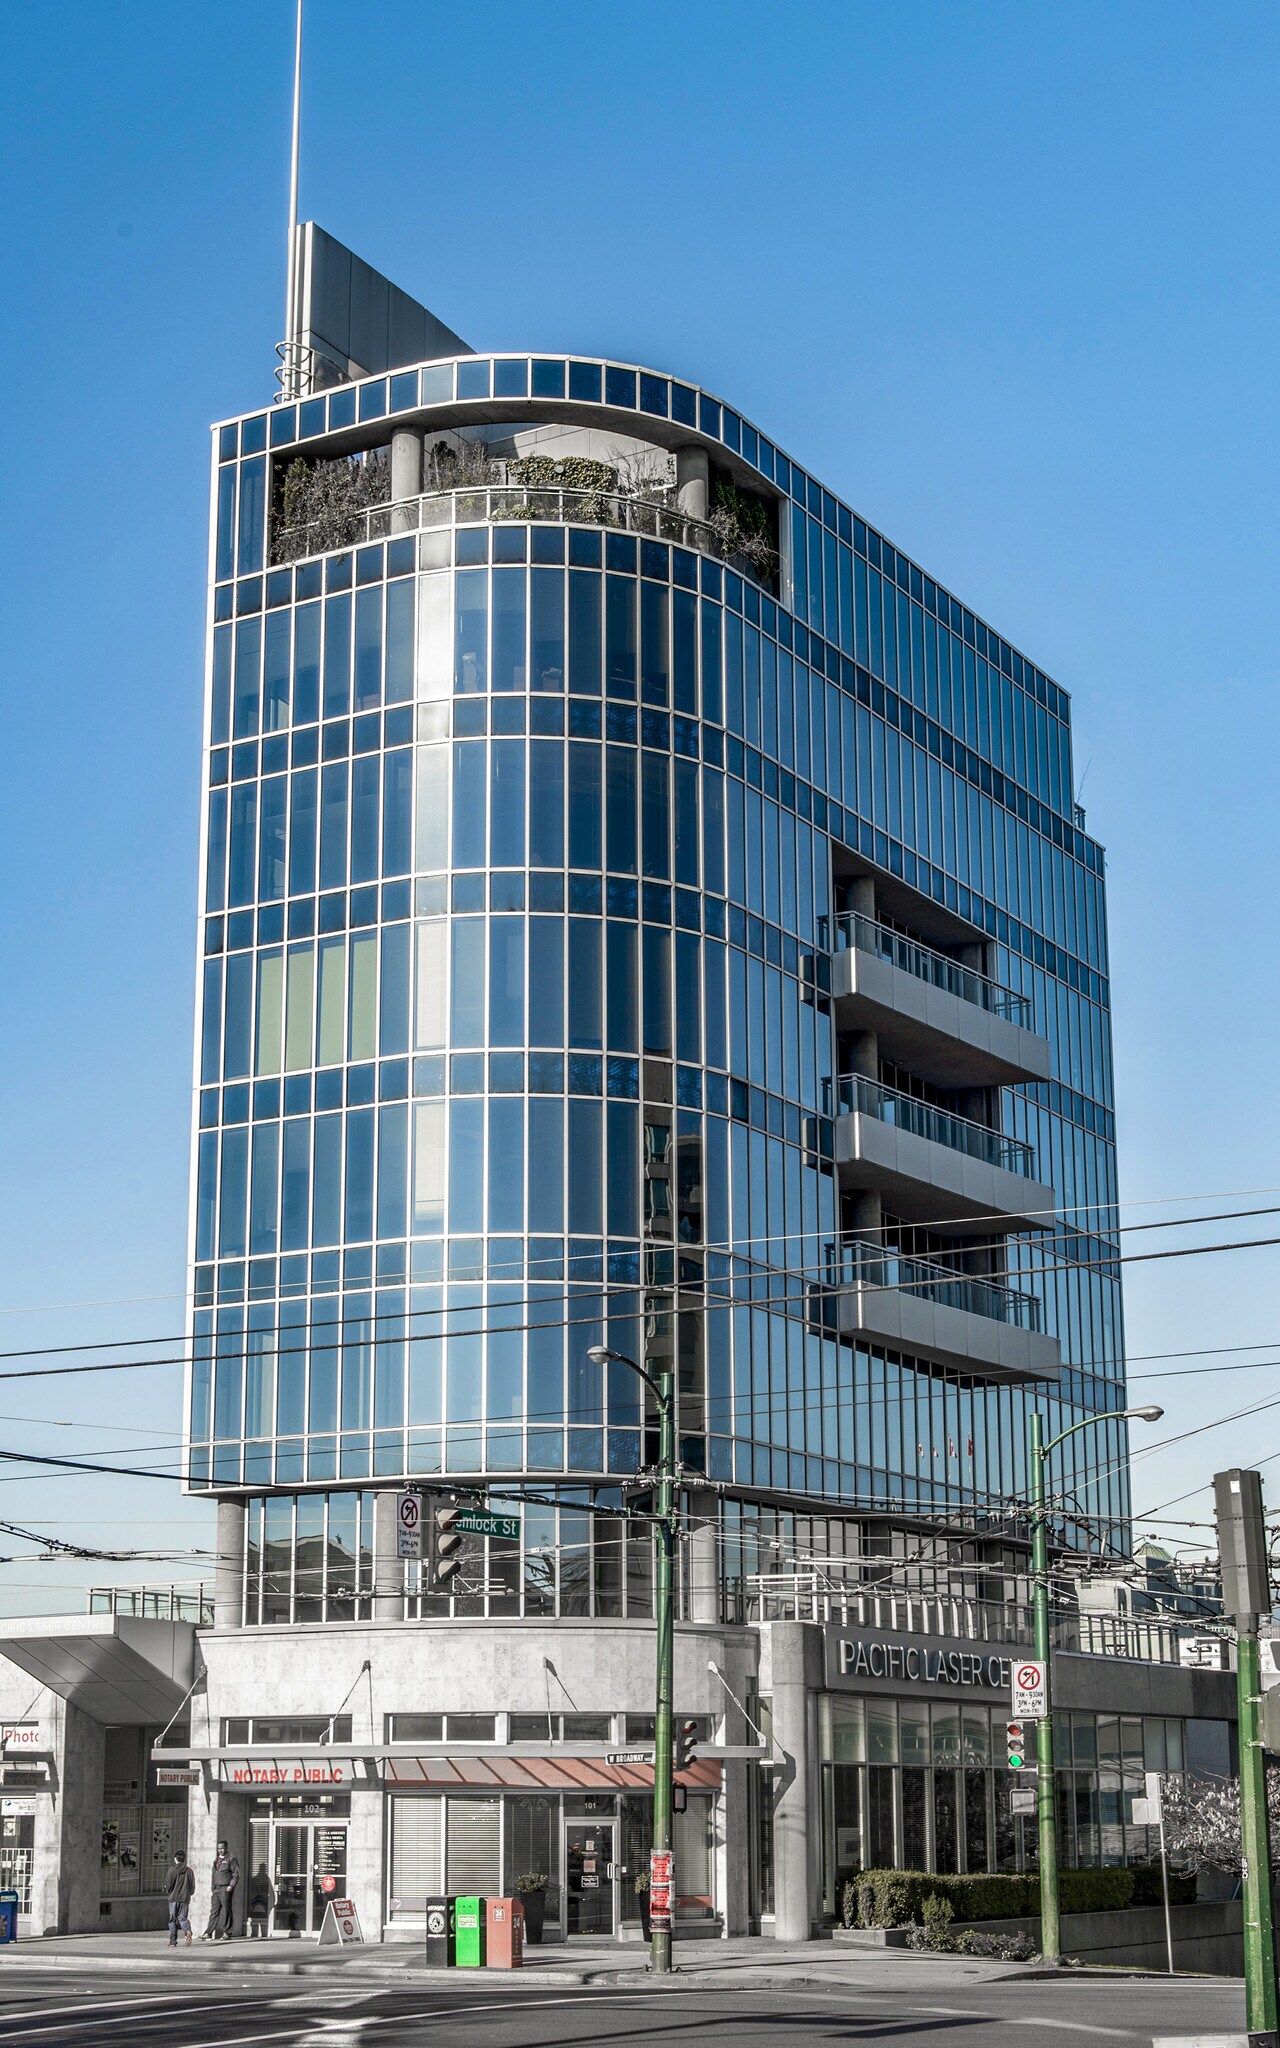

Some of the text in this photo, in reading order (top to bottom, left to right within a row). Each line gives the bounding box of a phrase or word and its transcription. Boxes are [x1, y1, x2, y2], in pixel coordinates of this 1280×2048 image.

[456, 1514, 516, 1536] emlock St
[29, 1621, 61, 1632] LASER
[64, 1618, 107, 1631] CENTRE
[839, 1639, 920, 1680] PACIFIC
[923, 1648, 983, 1686] LASER
[608, 1755, 615, 1763] W
[616, 1754, 645, 1763] BROADWAY
[160, 1773, 199, 1783] NOTARY PUBLIC
[233, 1768, 343, 1784] NOTARY PUBLIC
[304, 1804, 320, 1813] 102
[584, 1802, 597, 1810] 101
